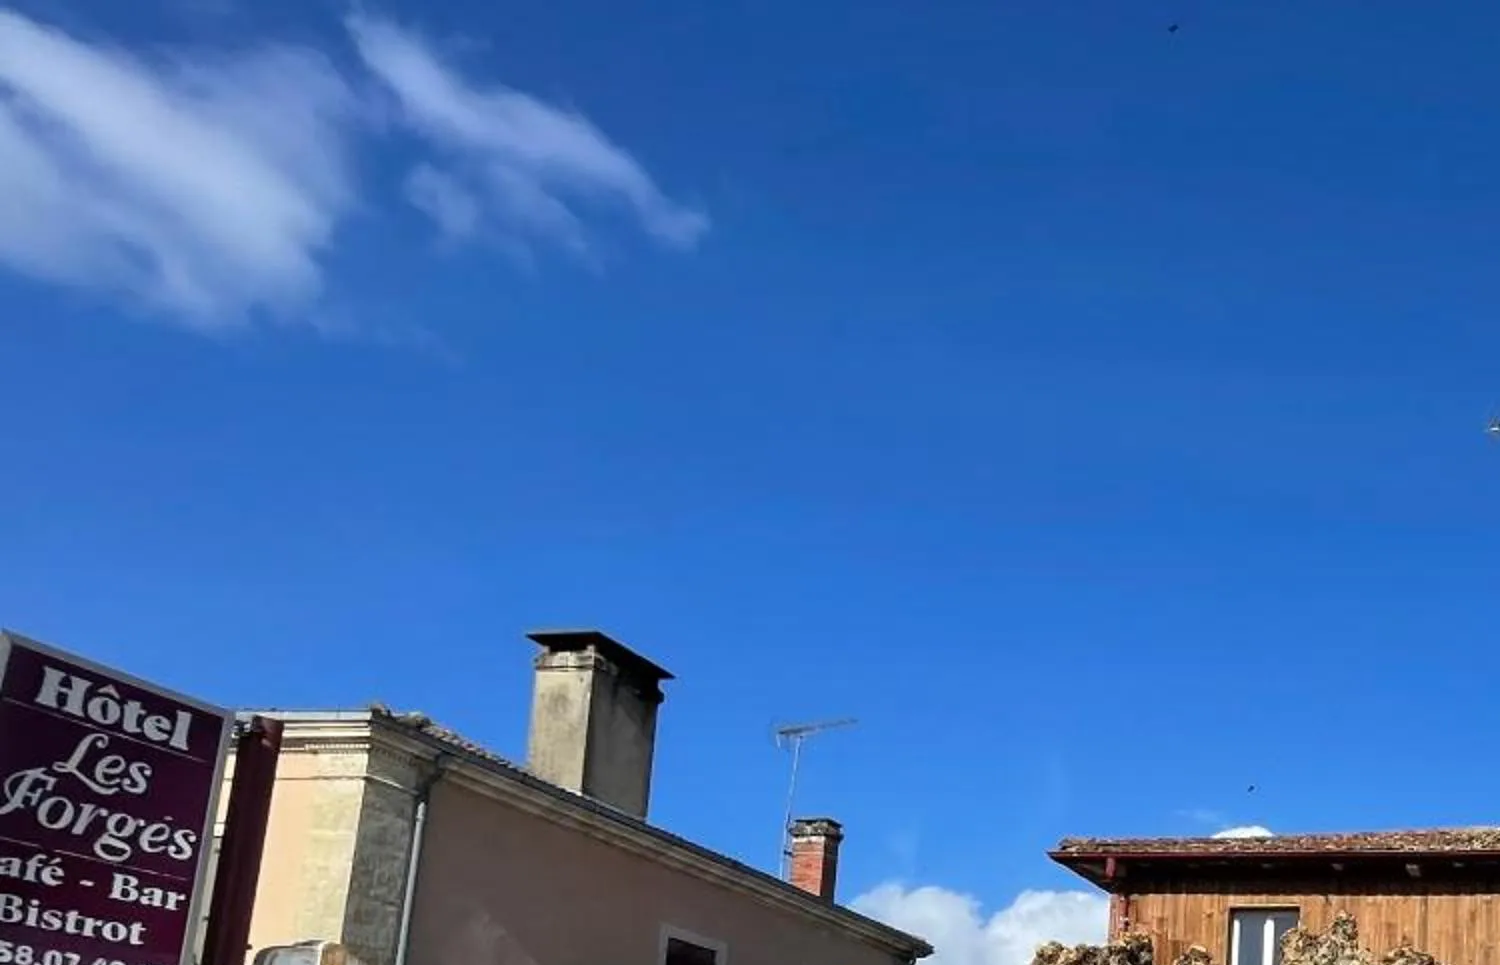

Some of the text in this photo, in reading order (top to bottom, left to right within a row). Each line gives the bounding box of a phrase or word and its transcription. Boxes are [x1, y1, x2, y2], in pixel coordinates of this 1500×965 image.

[35, 666, 192, 750] Hôtel
[53, 733, 152, 795] Les
[0, 854, 65, 886] afé
[108, 873, 187, 911] Bar
[0, 893, 147, 945] Bistrot
